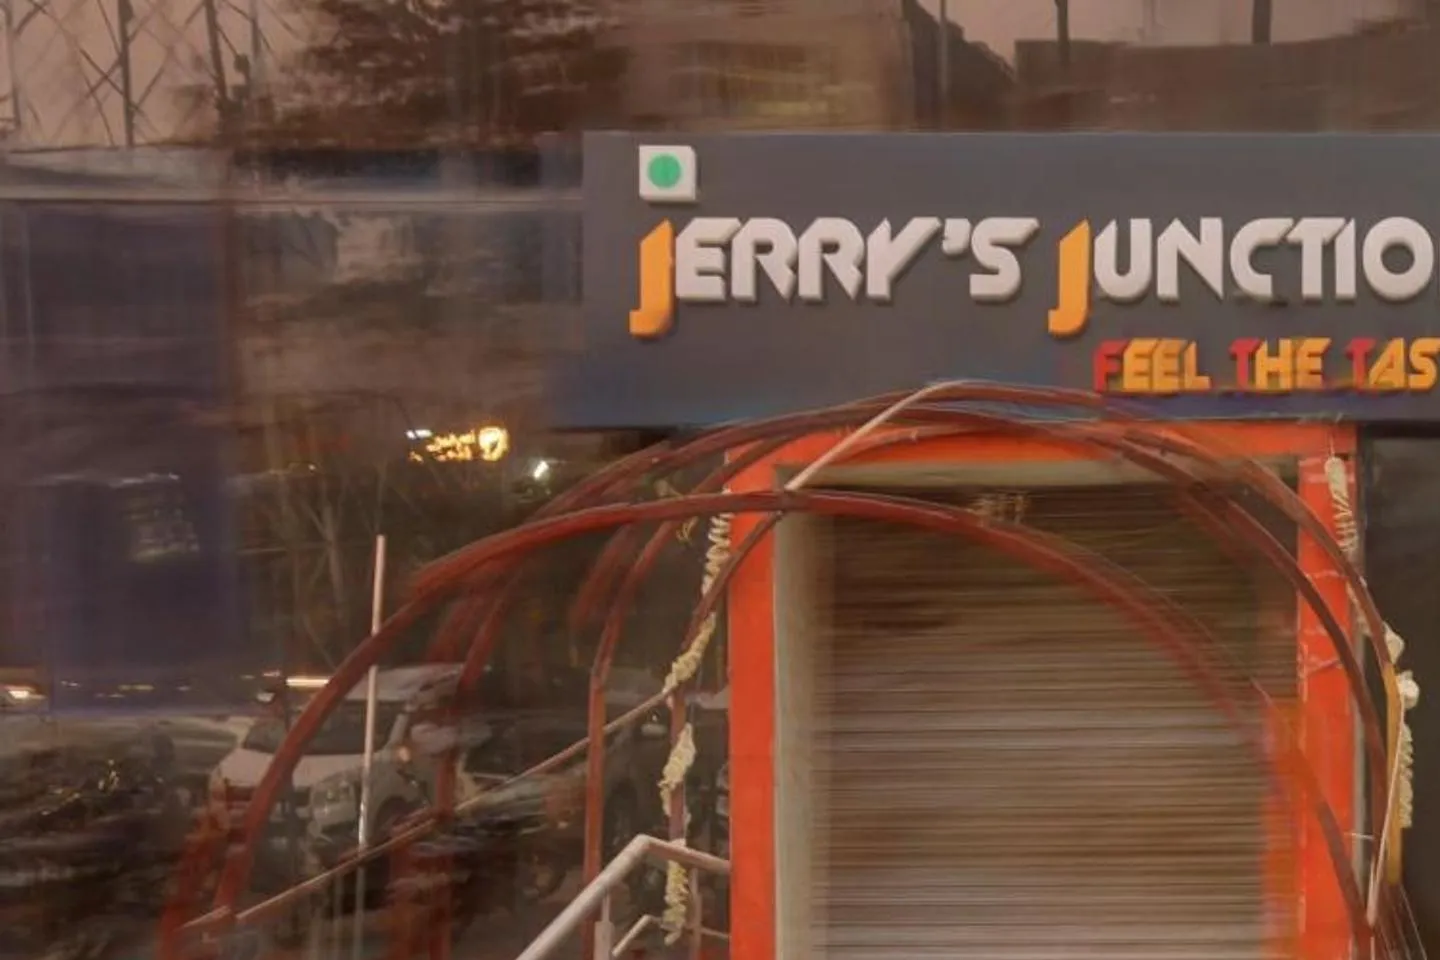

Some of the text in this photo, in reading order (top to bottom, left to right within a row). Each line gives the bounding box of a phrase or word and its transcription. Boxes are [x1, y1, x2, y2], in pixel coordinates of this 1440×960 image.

[629, 216, 1040, 337] JERRY'S
[1093, 337, 1212, 392] FEEL
[1230, 337, 1331, 391] THE
